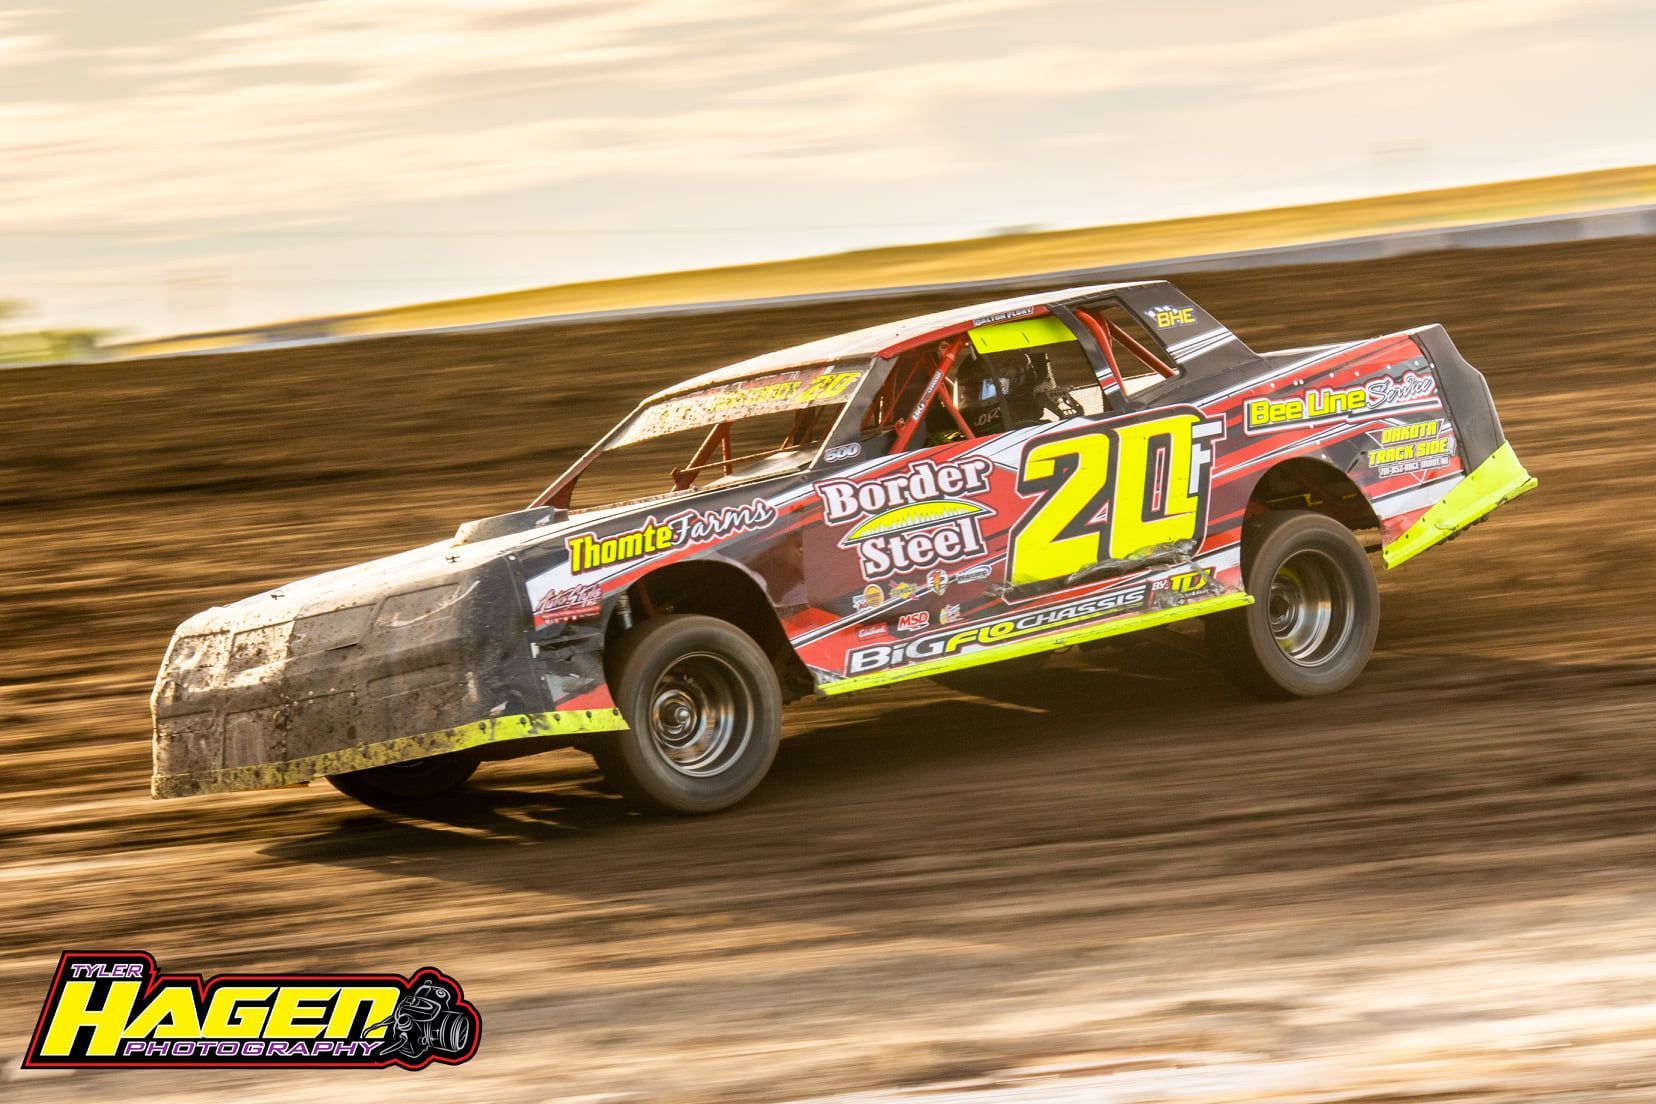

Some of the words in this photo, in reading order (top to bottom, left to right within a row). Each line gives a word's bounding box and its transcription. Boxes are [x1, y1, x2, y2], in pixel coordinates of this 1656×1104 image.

[1156, 307, 1196, 328] BHE
[1250, 399, 1303, 426] Bee
[1308, 389, 1367, 418] Line
[1366, 374, 1433, 410] Service
[1381, 420, 1438, 444] DAKOTA
[826, 443, 860, 461] 500
[1368, 444, 1415, 466] TRACK
[1416, 438, 1449, 457] SIDE
[820, 459, 990, 520] Border
[569, 524, 673, 573] Thomte
[669, 502, 773, 545] Farms
[860, 521, 985, 576] Steel
[899, 611, 929, 627] MSD
[1015, 589, 1147, 630] CHASSIS
